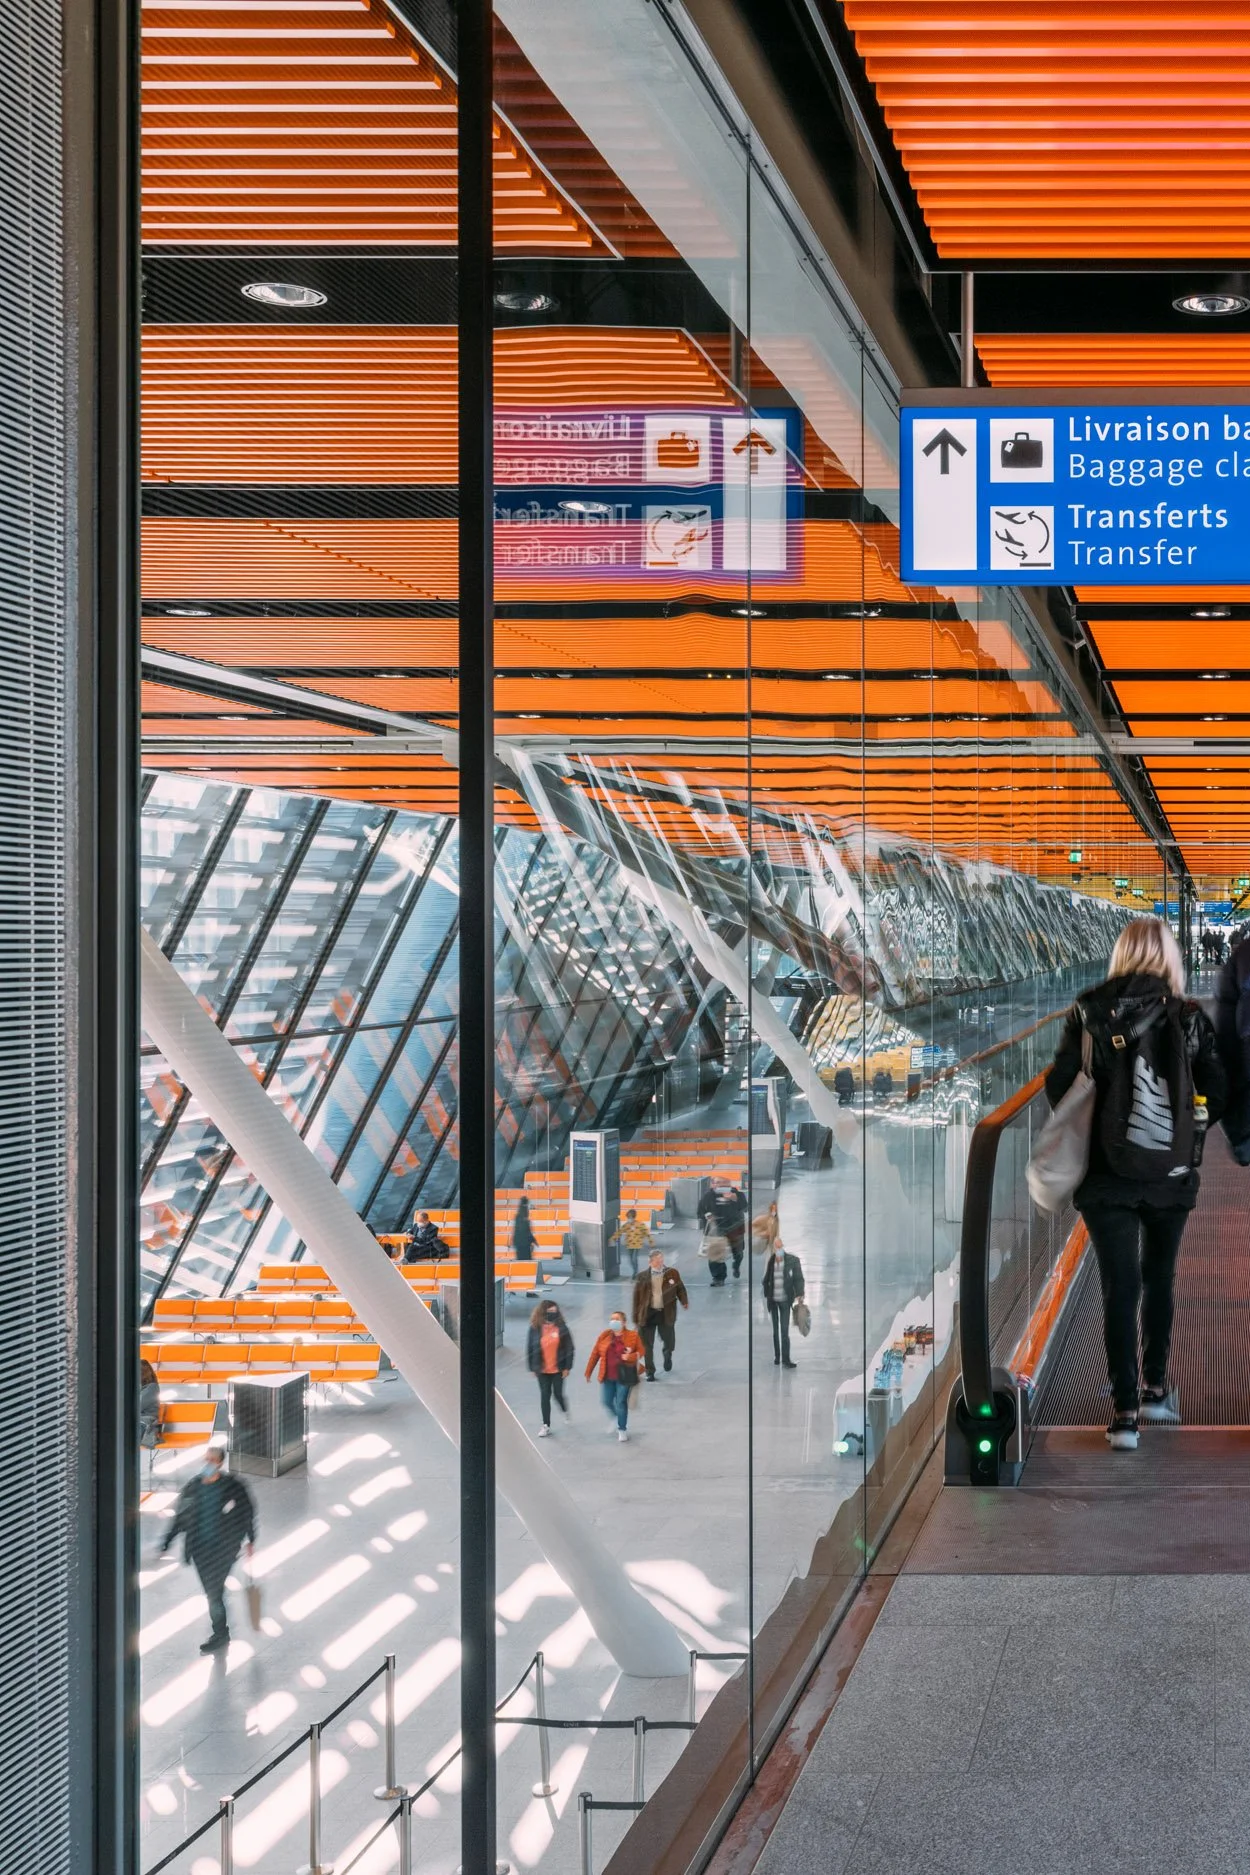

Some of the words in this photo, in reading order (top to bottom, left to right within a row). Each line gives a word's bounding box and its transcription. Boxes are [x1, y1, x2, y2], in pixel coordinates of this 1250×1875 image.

[1069, 414, 1211, 442] Livraison
[1069, 452, 1204, 487] Baggage
[1067, 500, 1229, 530] Transferts
[1067, 537, 1198, 567] Transfer
[1125, 1054, 1175, 1151] NIKE
